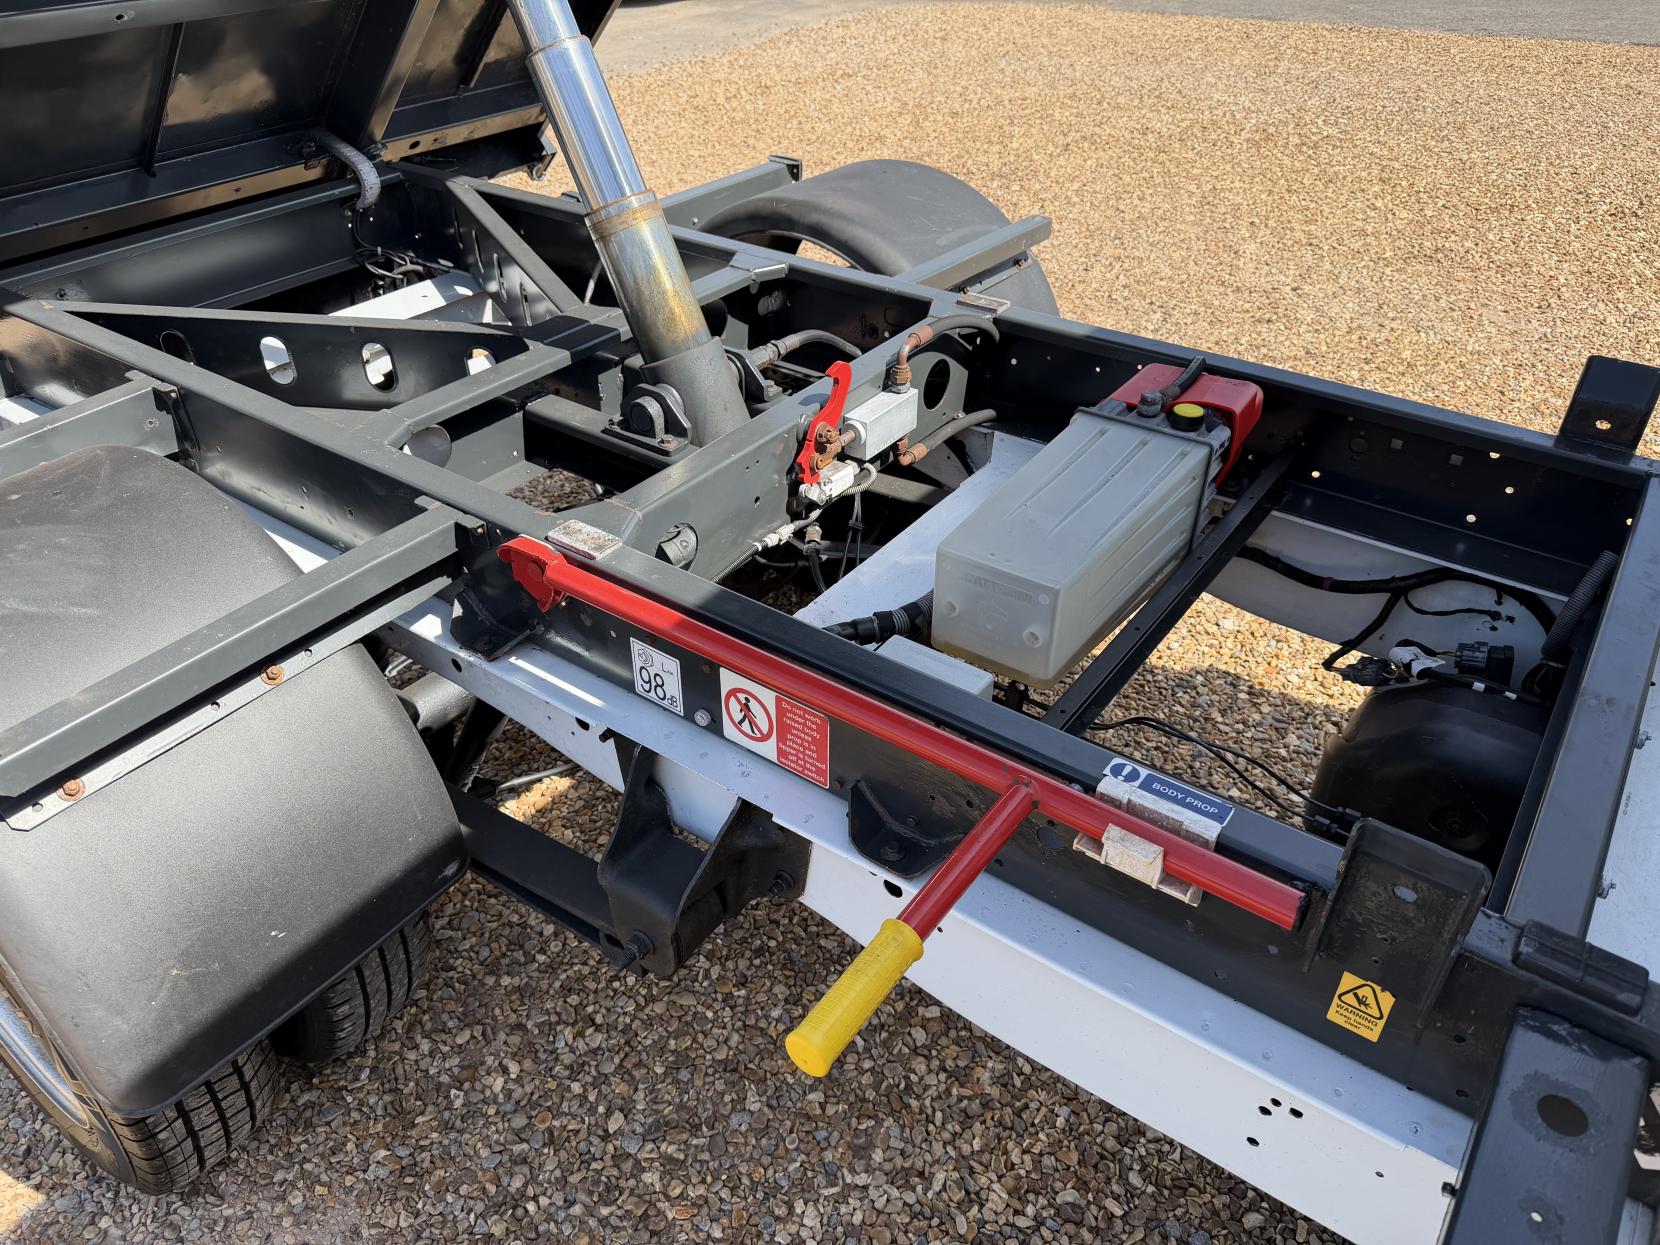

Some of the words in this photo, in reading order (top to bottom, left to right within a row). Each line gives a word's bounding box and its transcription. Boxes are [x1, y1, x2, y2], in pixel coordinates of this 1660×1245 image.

[640, 667, 666, 701] 98
[667, 695, 678, 708] dB
[782, 702, 791, 710] Do
[792, 707, 804, 717] not
[804, 713, 821, 724] work
[786, 712, 804, 724] under
[806, 720, 817, 730] the
[783, 717, 803, 730] raised
[804, 725, 820, 739] body
[791, 729, 812, 742] unless
[786, 740, 804, 752] place
[804, 749, 817, 758] and
[787, 734, 802, 745] prop
[803, 740, 809, 748] is
[778, 742, 797, 756] tipper
[804, 755, 826, 770] turned
[788, 754, 797, 762] off
[805, 762, 816, 772] the
[779, 756, 803, 772] isolator
[804, 769, 825, 783] switch
[1152, 782, 1185, 799] BODY
[1185, 797, 1218, 813] PROP
[1335, 1010, 1353, 1021] Keep
[1353, 1018, 1374, 1032] hands
[1336, 1003, 1378, 1027] WARNING
[1344, 1020, 1361, 1030] clear
